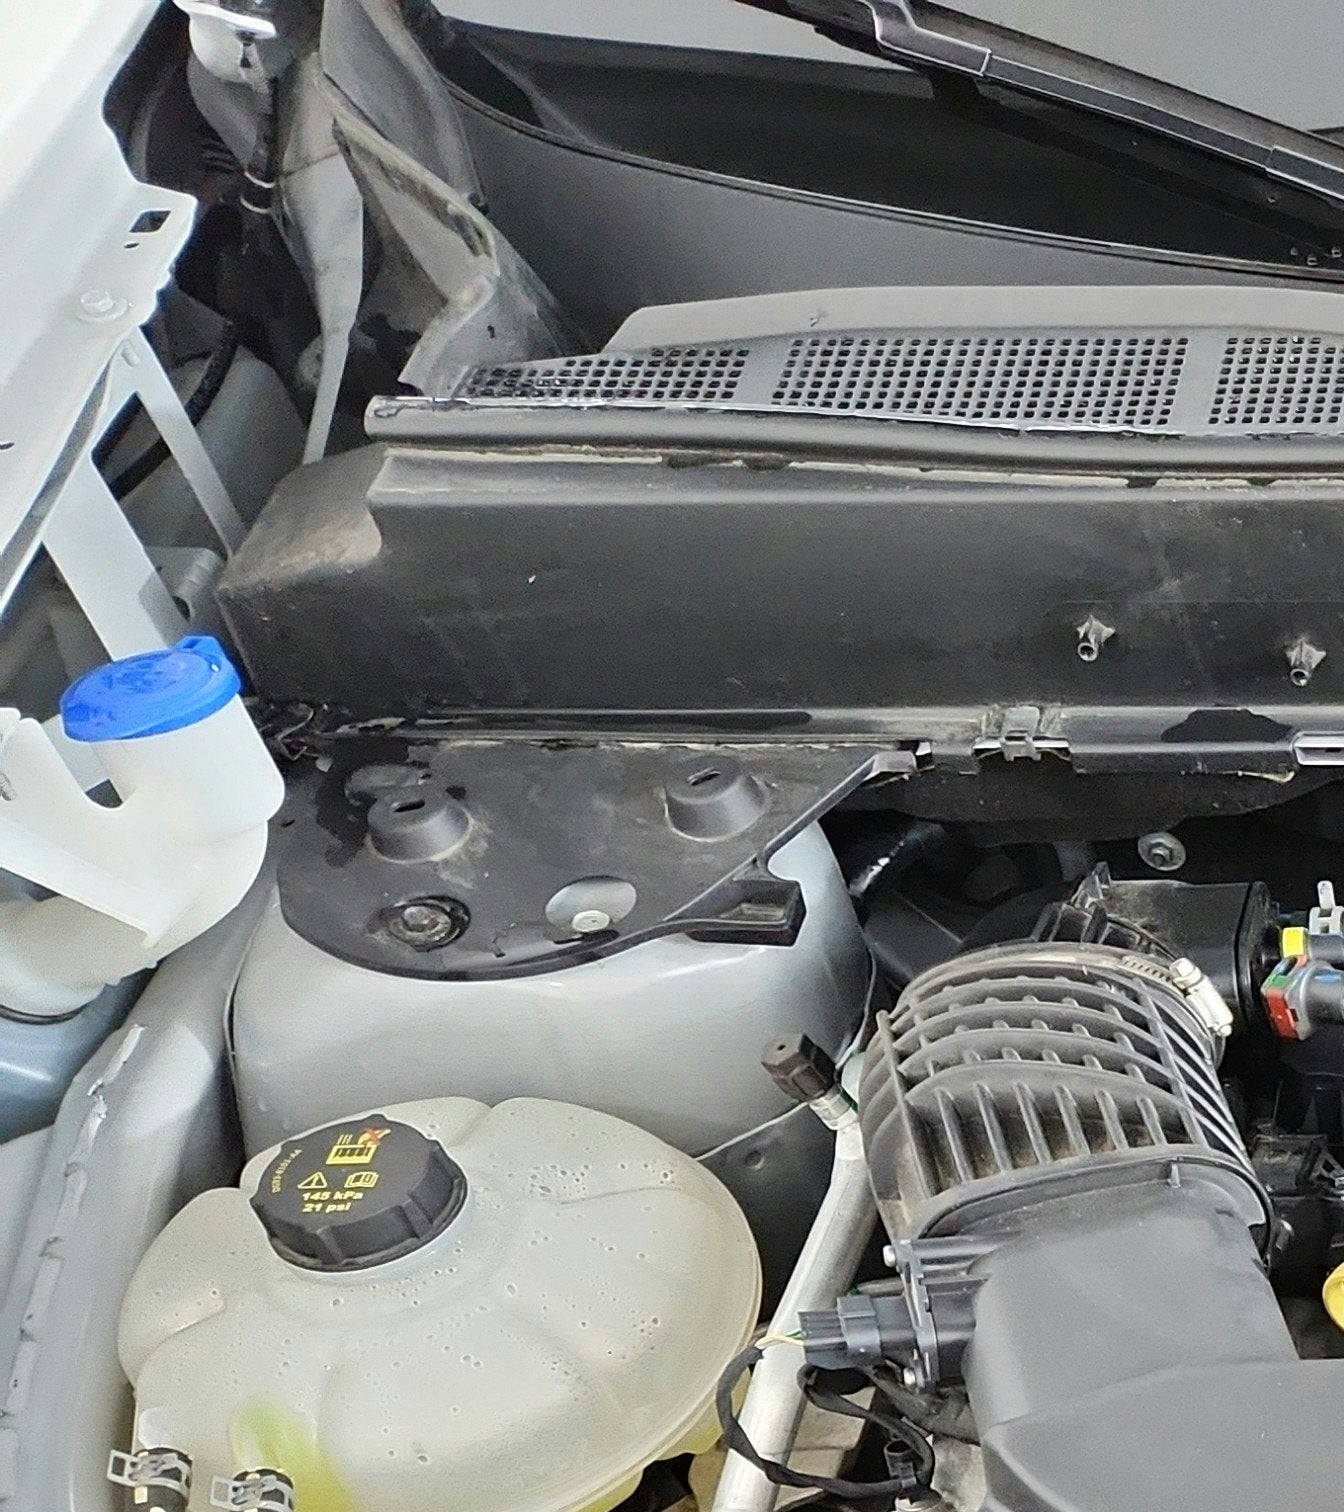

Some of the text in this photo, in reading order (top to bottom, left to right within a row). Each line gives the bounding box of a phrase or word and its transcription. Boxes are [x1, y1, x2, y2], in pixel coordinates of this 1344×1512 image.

[302, 1190, 364, 1201] 145 kPa
[302, 1201, 352, 1214] 21 psi
